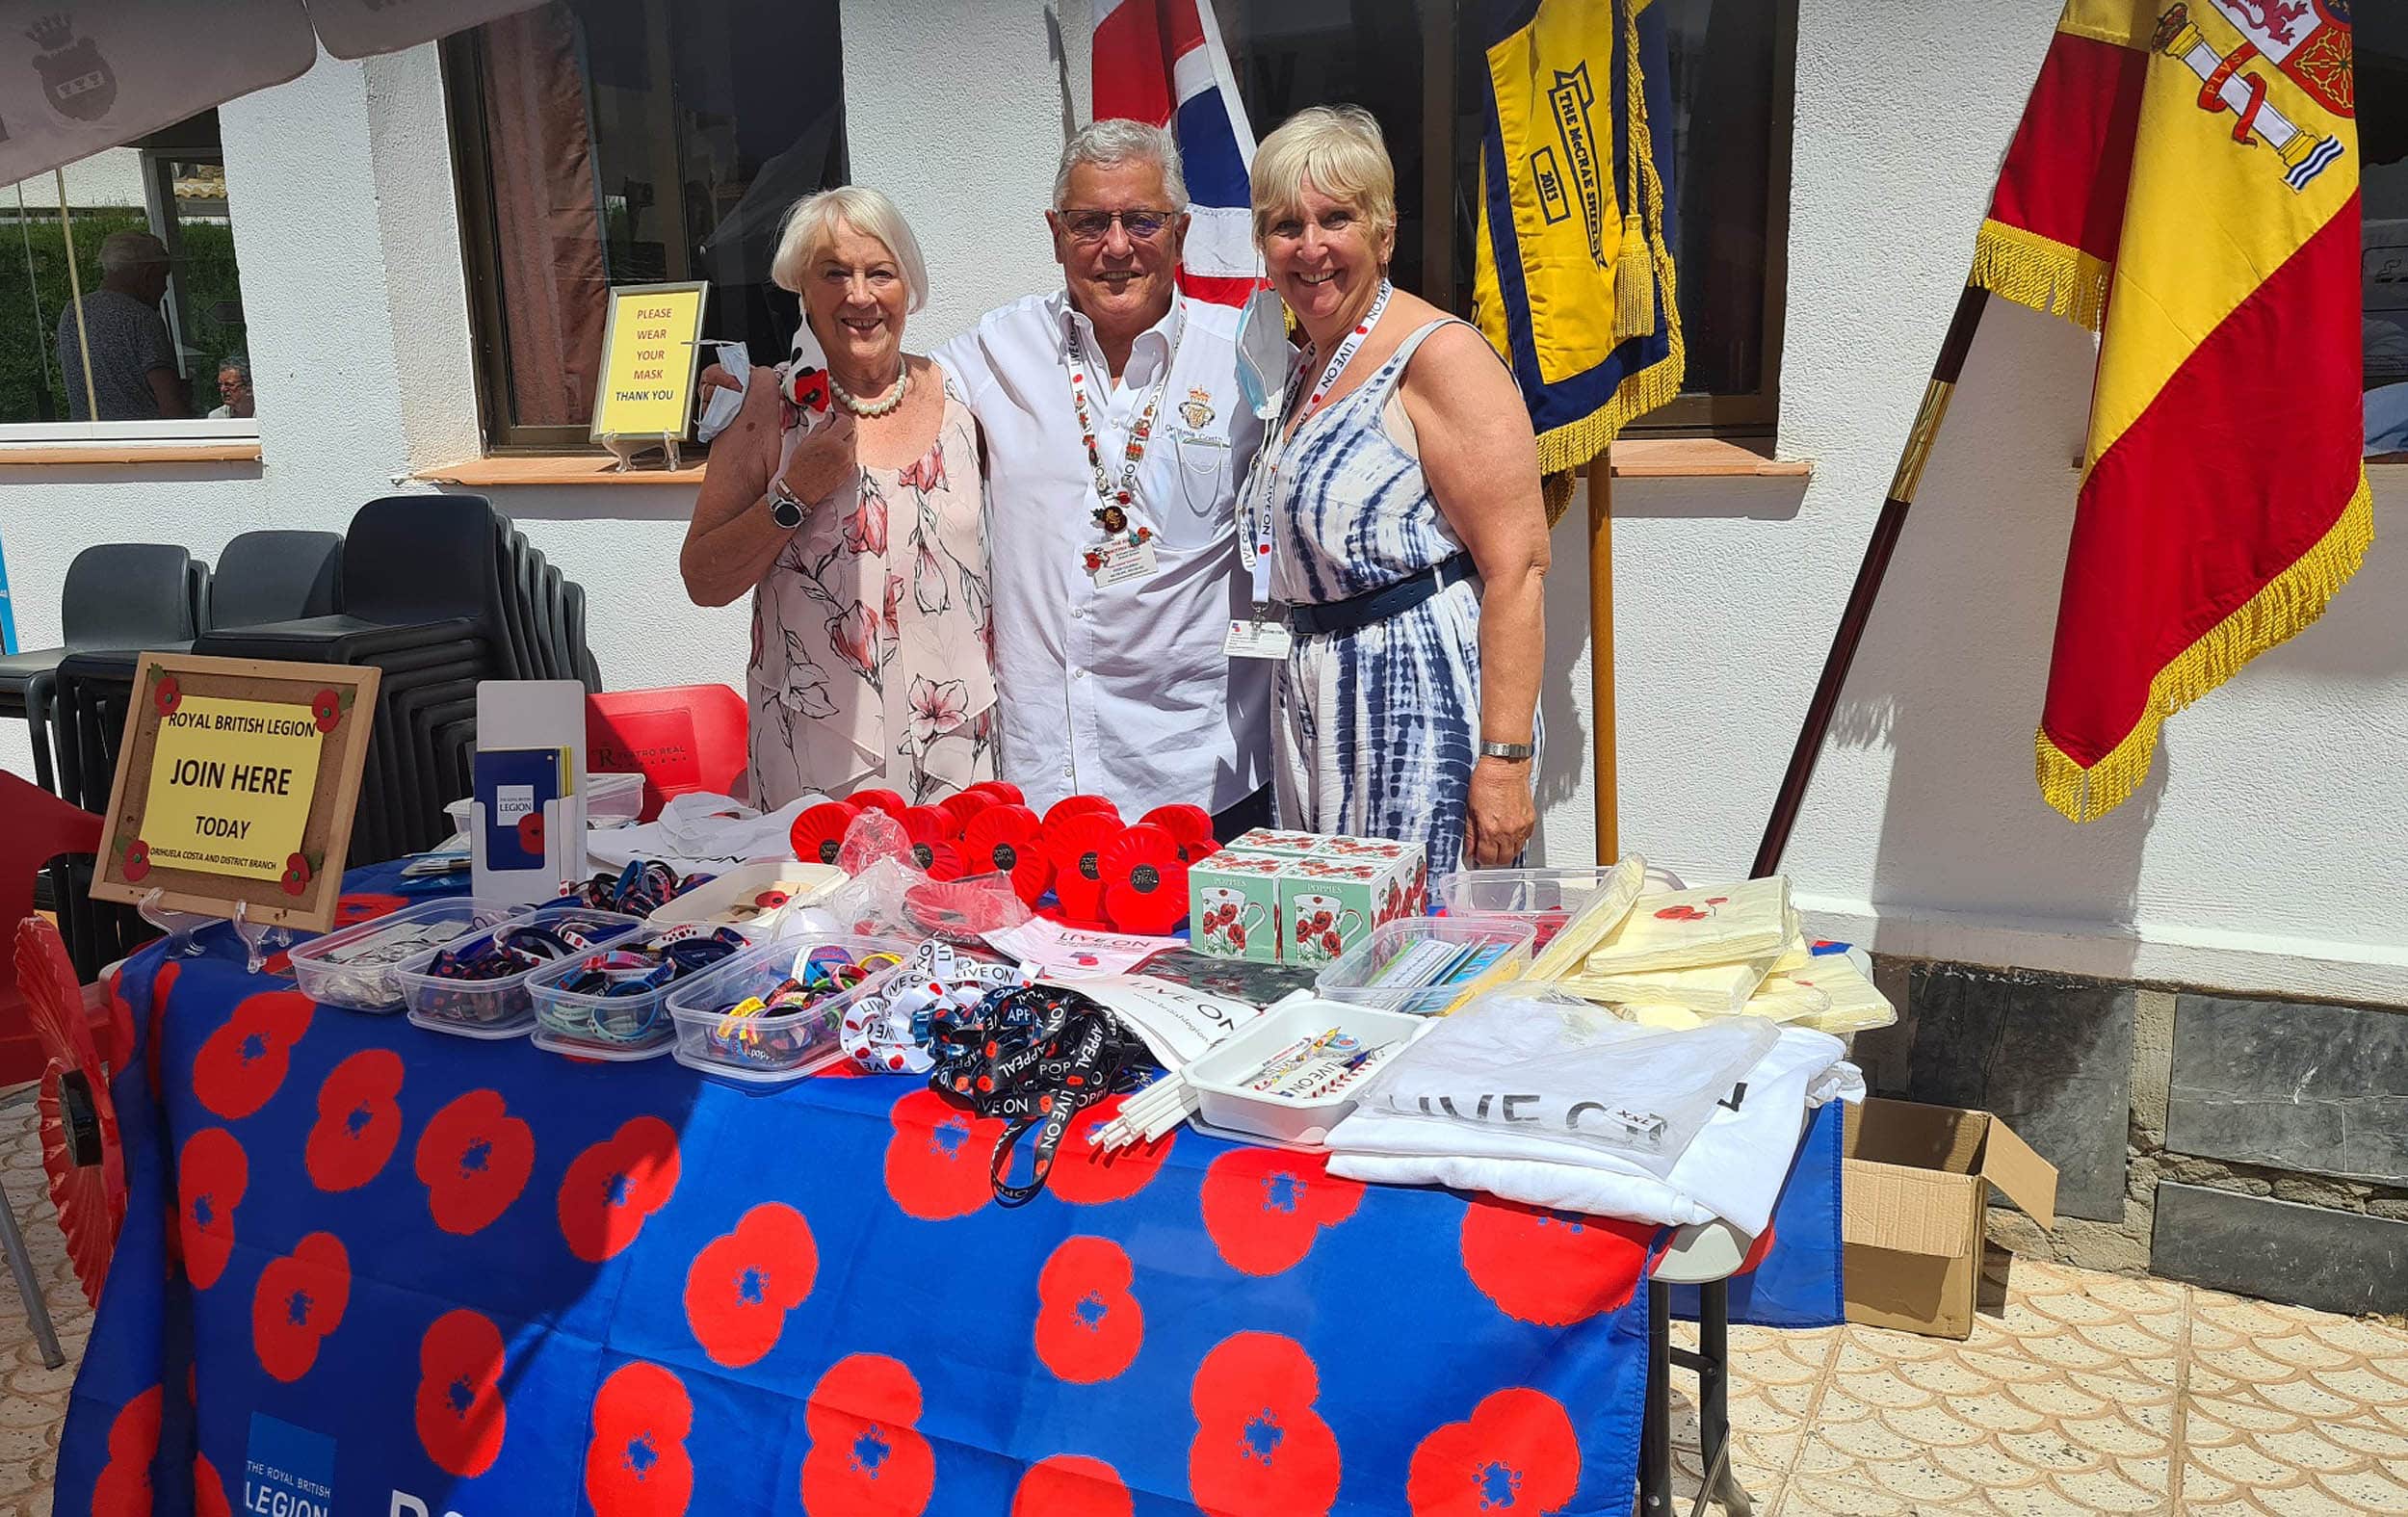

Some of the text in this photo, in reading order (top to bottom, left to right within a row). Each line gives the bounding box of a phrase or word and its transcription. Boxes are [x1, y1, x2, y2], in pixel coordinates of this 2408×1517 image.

[2206, 53, 2242, 94] PLVS
[1559, 91, 1579, 126] THE
[637, 308, 672, 320] PLEASE
[1367, 301, 1383, 322] ON
[637, 329, 667, 340] WEAR
[637, 351, 666, 361] YOUR
[1068, 344, 1081, 367] LIVE
[1322, 342, 1356, 389] LIVE ON
[633, 370, 664, 380] MASK
[615, 390, 674, 402] THANK YOU
[1262, 513, 1271, 536] ON
[168, 712, 316, 738] ROYAL BRITISH LEGION
[170, 758, 293, 796] JOIN HERE
[499, 801, 532, 812] LEGION
[196, 816, 251, 840] TODAY
[149, 847, 277, 871] ORIHUELA COSTA AND DISTRICT BRANCH
[1214, 878, 1247, 887] POPPIES
[1307, 883, 1343, 894] POPPIES
[1059, 931, 1107, 943] LIVE
[1112, 939, 1152, 948] ON
[955, 966, 1014, 983] LIVE ON
[1047, 1007, 1063, 1033] ON
[1075, 1023, 1104, 1069] APPEAL
[998, 1041, 1047, 1078] APPEAL
[1310, 1061, 1341, 1082] LIVE
[1003, 1097, 1030, 1114] ON
[1040, 1089, 1076, 1149] LIVE ON
[247, 1460, 331, 1500] THE ROYAL BRITISH
[246, 1480, 329, 1517] LEGION
